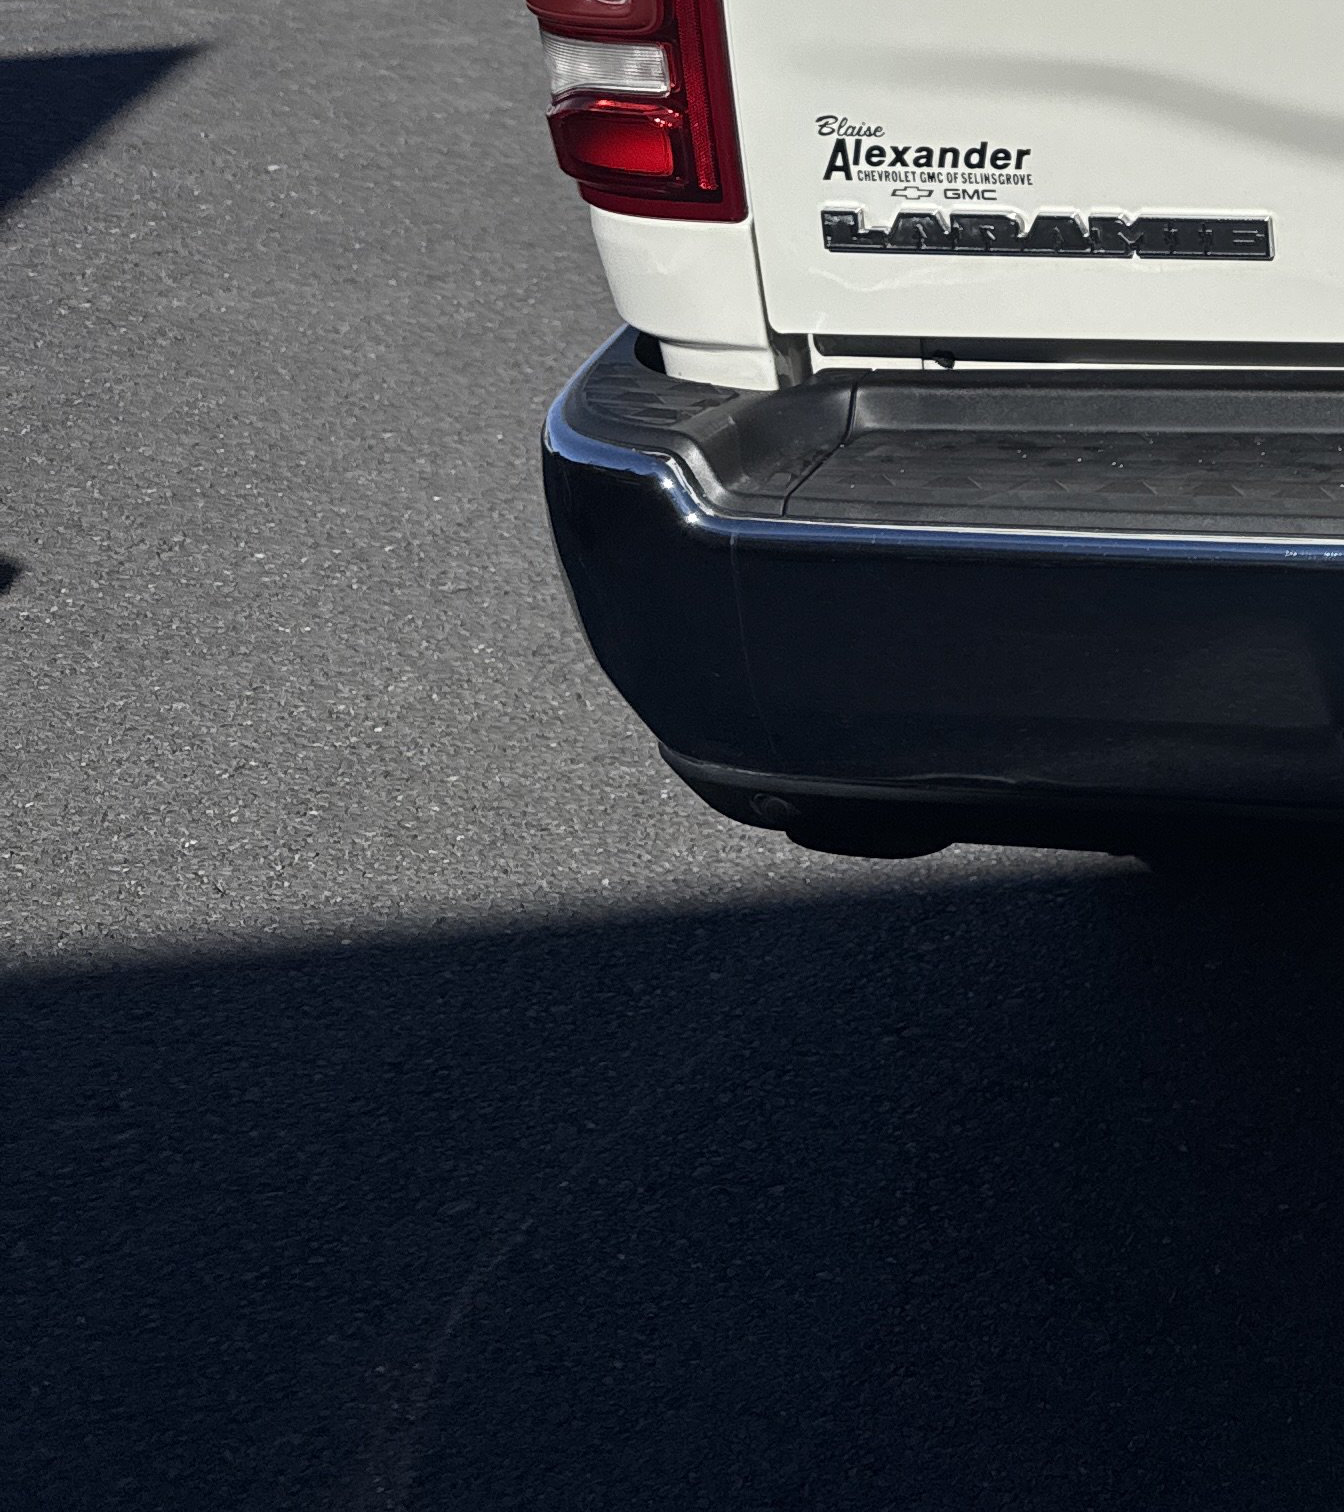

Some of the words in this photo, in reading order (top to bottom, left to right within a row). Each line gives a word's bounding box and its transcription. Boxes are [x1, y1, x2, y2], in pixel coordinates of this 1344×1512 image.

[815, 115, 886, 138] Blaise
[823, 138, 1031, 181] Alexander
[857, 170, 917, 183] CHEVROLET
[919, 171, 944, 183] GMC
[946, 172, 959, 183] OF
[961, 172, 1033, 186] SELINSGROVE
[943, 188, 998, 201] GMC
